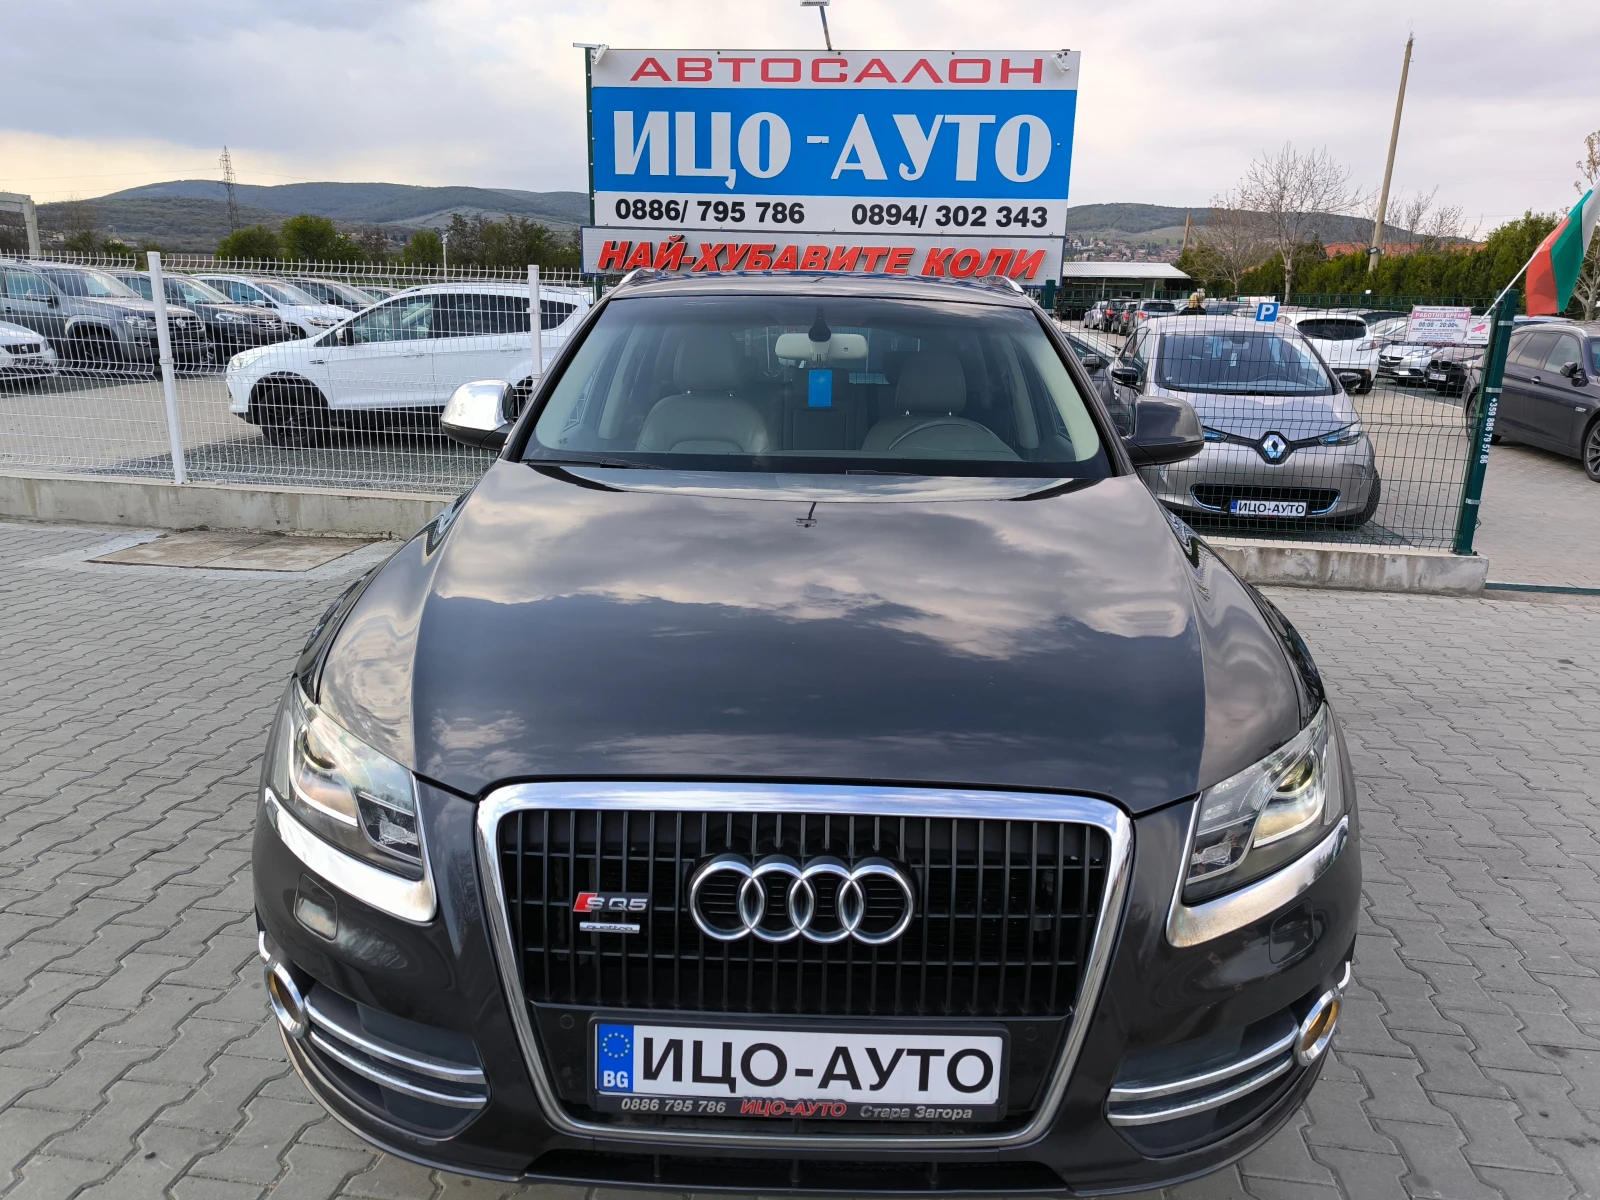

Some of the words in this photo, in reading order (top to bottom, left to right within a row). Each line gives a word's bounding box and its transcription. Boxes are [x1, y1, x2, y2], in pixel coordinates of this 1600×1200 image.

[629, 57, 1043, 84] АВТОСАЛОН
[615, 198, 689, 223] 0886/
[697, 201, 746, 223] 795
[755, 202, 805, 224] 786
[851, 203, 928, 228] 0894/
[935, 205, 987, 227] 302
[995, 206, 1048, 228] 343
[597, 234, 915, 275] НАЙ-ХУБАВИТЕ
[921, 246, 1047, 279] КОЛИ
[1260, 304, 1274, 320] P
[1488, 398, 1498, 416] +359
[1485, 418, 1495, 431] 886
[1238, 502, 1305, 514] ИЦО-АУТО
[642, 1037, 994, 1093] ИЦО-АУТО
[603, 1070, 629, 1089] BG
[620, 1098, 660, 1111] 0886
[664, 1099, 694, 1113] 795
[697, 1101, 726, 1114] 786
[739, 1100, 847, 1118] ИЦО-АУТО
[860, 1105, 910, 1120] Стара
[914, 1105, 973, 1121] Загора
